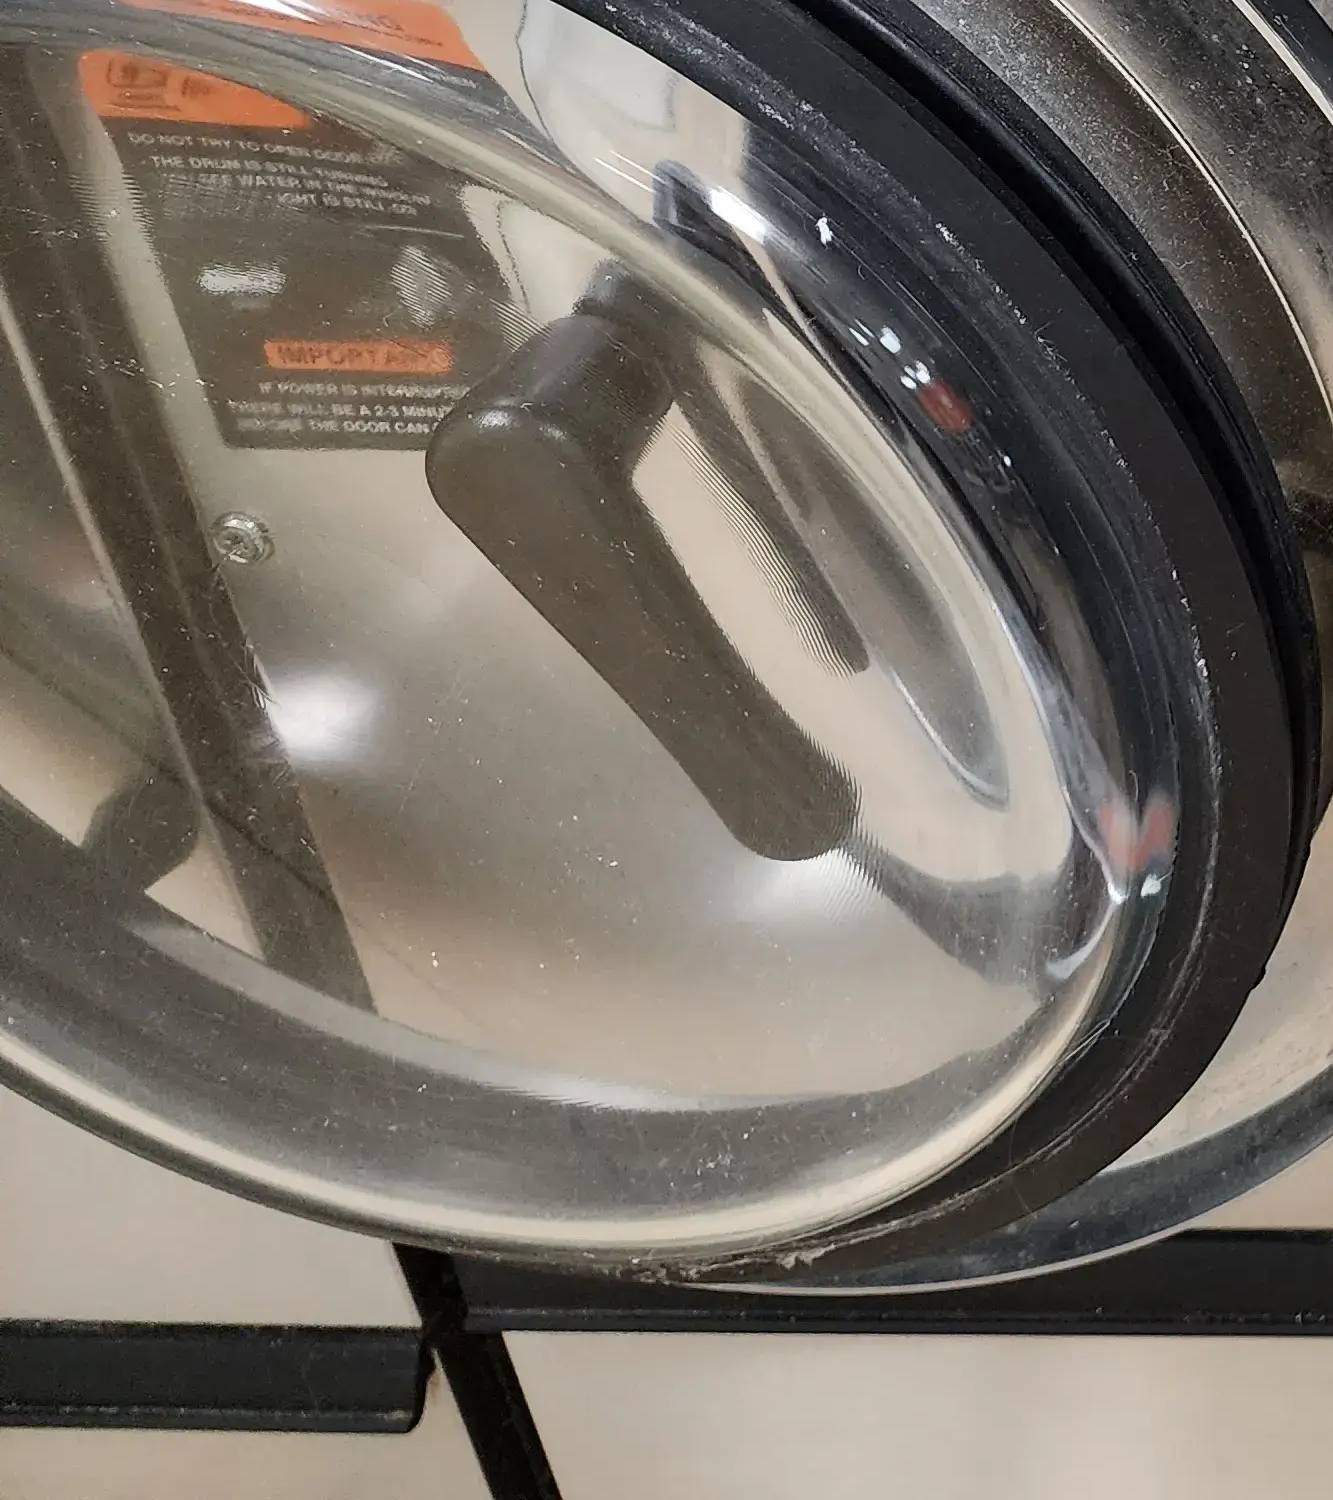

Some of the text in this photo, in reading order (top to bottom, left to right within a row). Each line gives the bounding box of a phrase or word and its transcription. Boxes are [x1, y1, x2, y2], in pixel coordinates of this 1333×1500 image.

[158, 134, 193, 147] NOT
[150, 155, 185, 168] THE
[277, 192, 317, 206] IGHT
